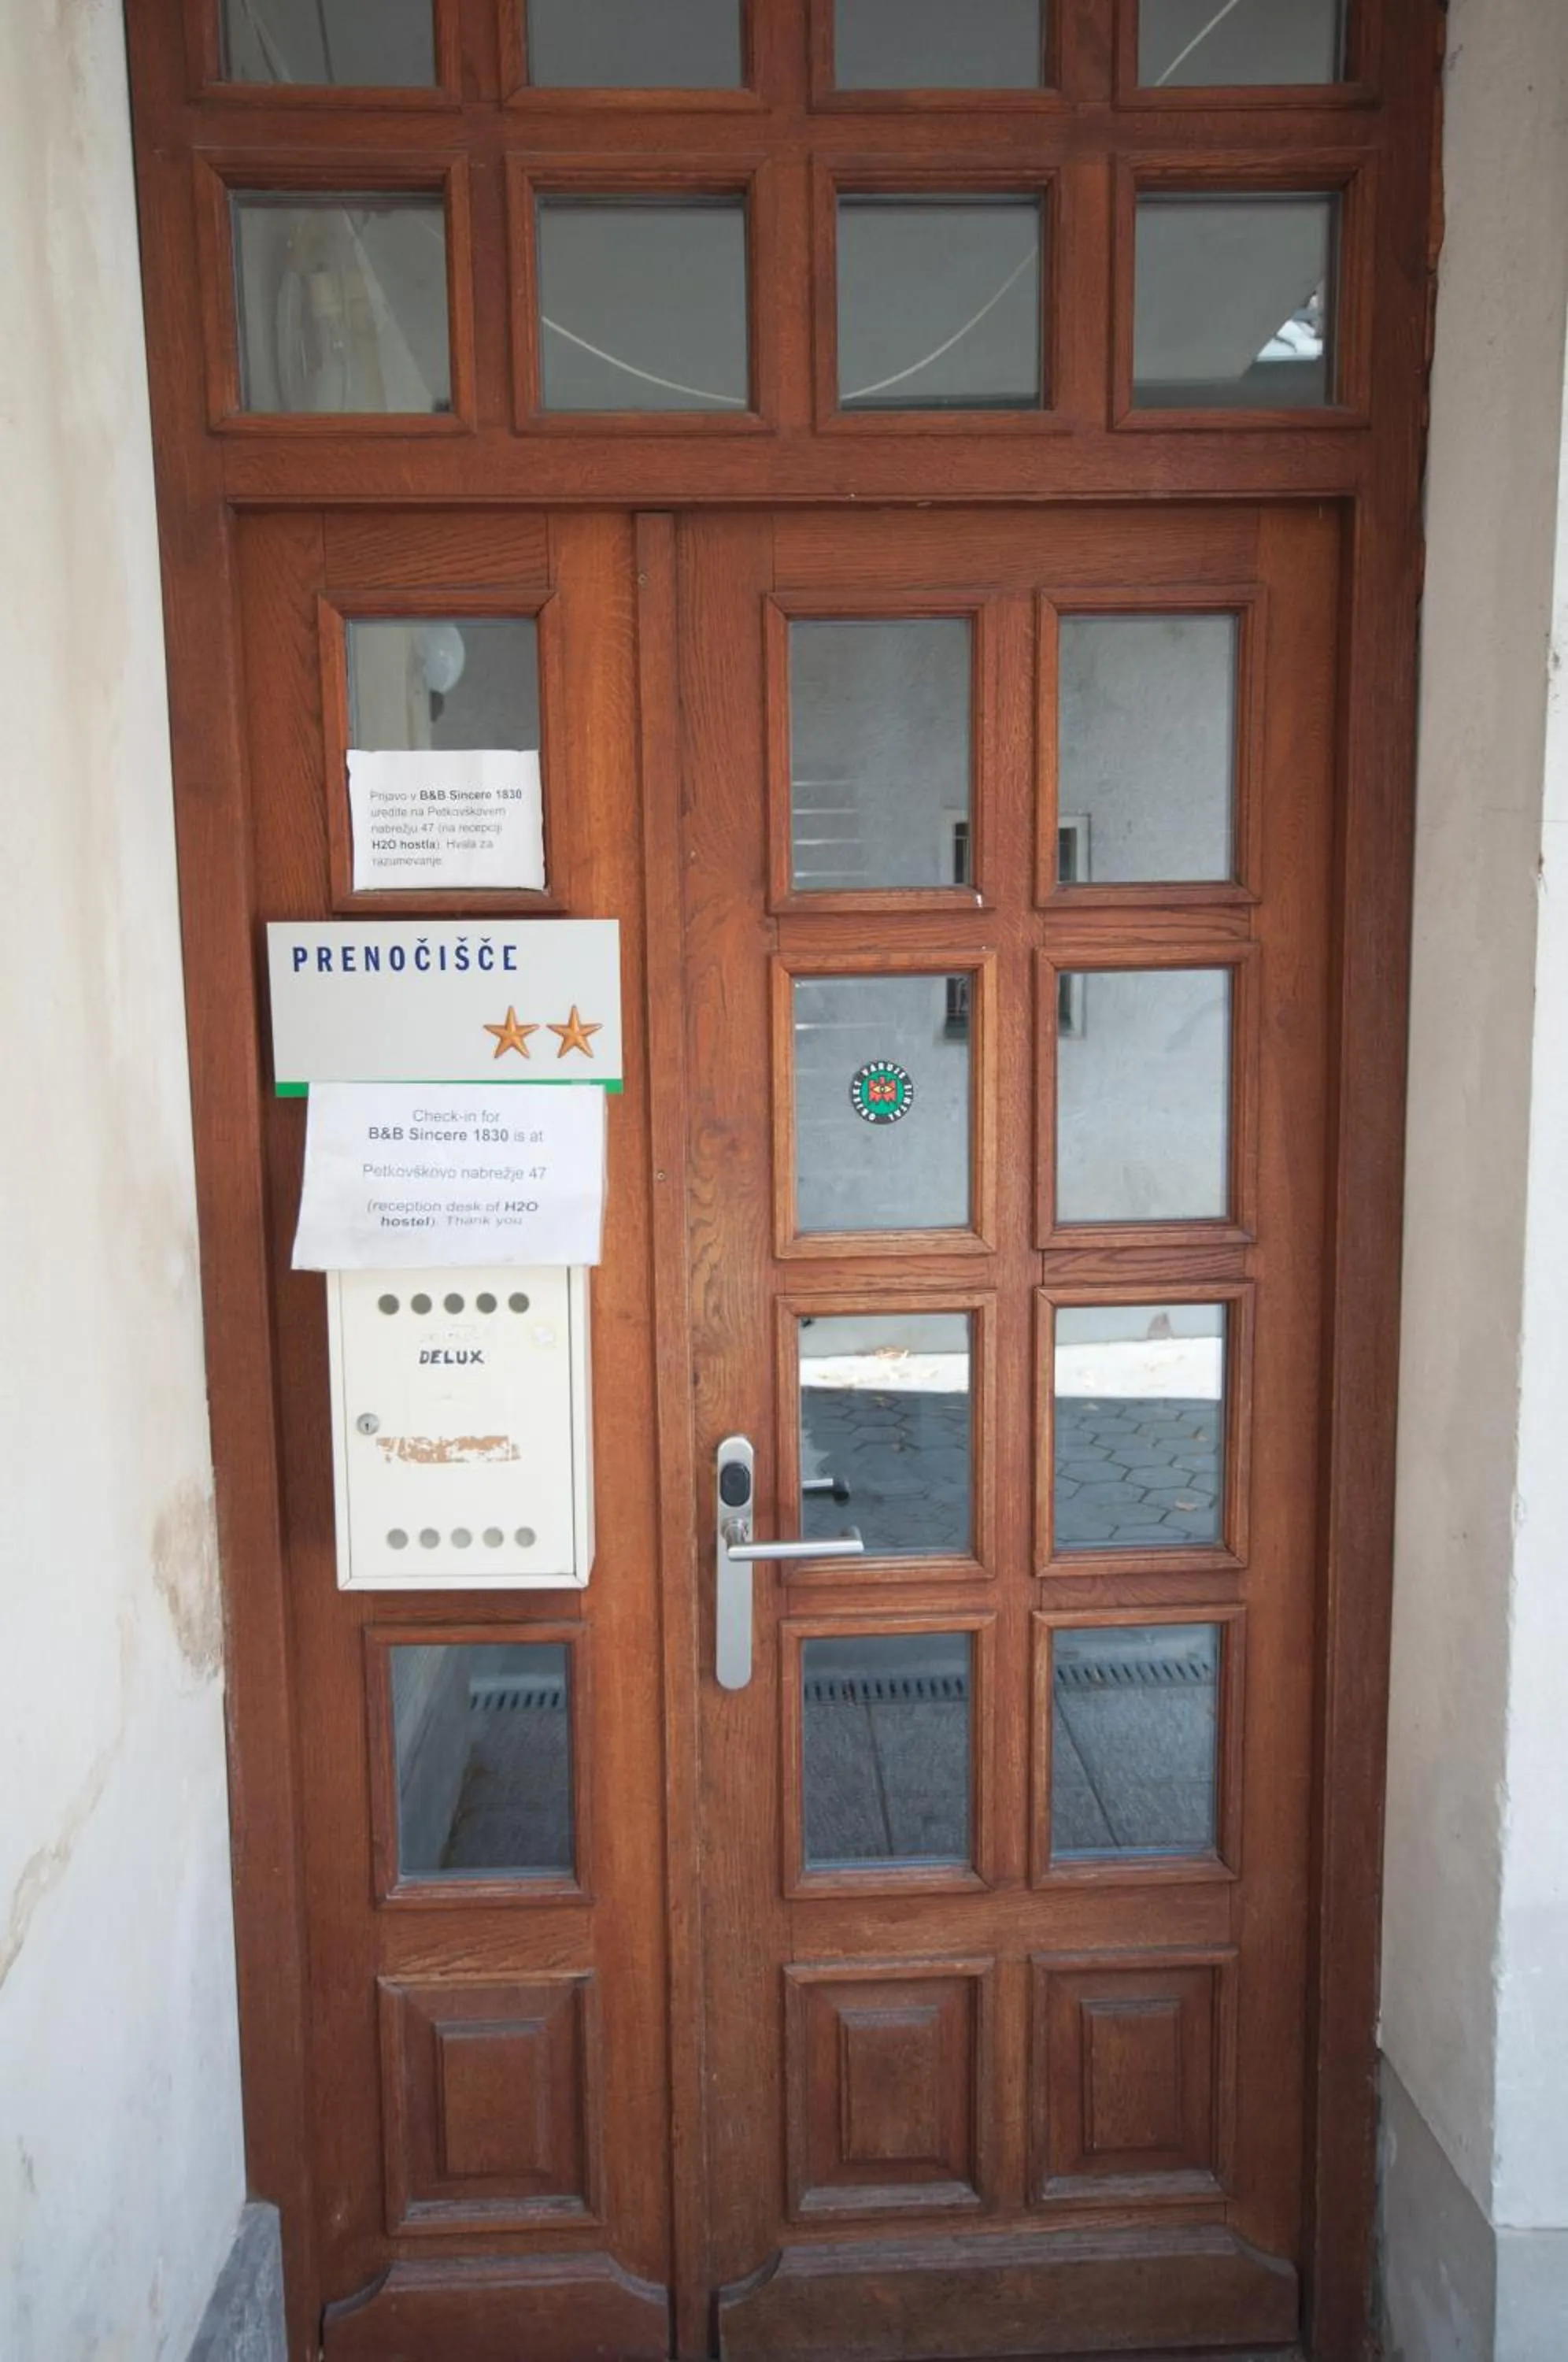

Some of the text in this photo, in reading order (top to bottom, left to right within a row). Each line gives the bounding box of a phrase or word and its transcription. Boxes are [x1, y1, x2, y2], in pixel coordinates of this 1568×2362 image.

[420, 790, 446, 801] B&B
[449, 790, 491, 801] Sincere
[496, 789, 522, 800] 1830
[420, 823, 435, 832] 47
[372, 839, 397, 850] H2O
[479, 840, 494, 849] za
[293, 936, 519, 973] PRENOČIŠČE
[412, 1109, 501, 1123] Check-in for
[368, 1126, 544, 1142] B&B Sincere 1830 is at
[528, 1166, 547, 1179] 47
[367, 1199, 538, 1213] (reception desk of H2O
[446, 1215, 490, 1227] Thank
[495, 1218, 523, 1229] you
[419, 1349, 485, 1364] DELUX
